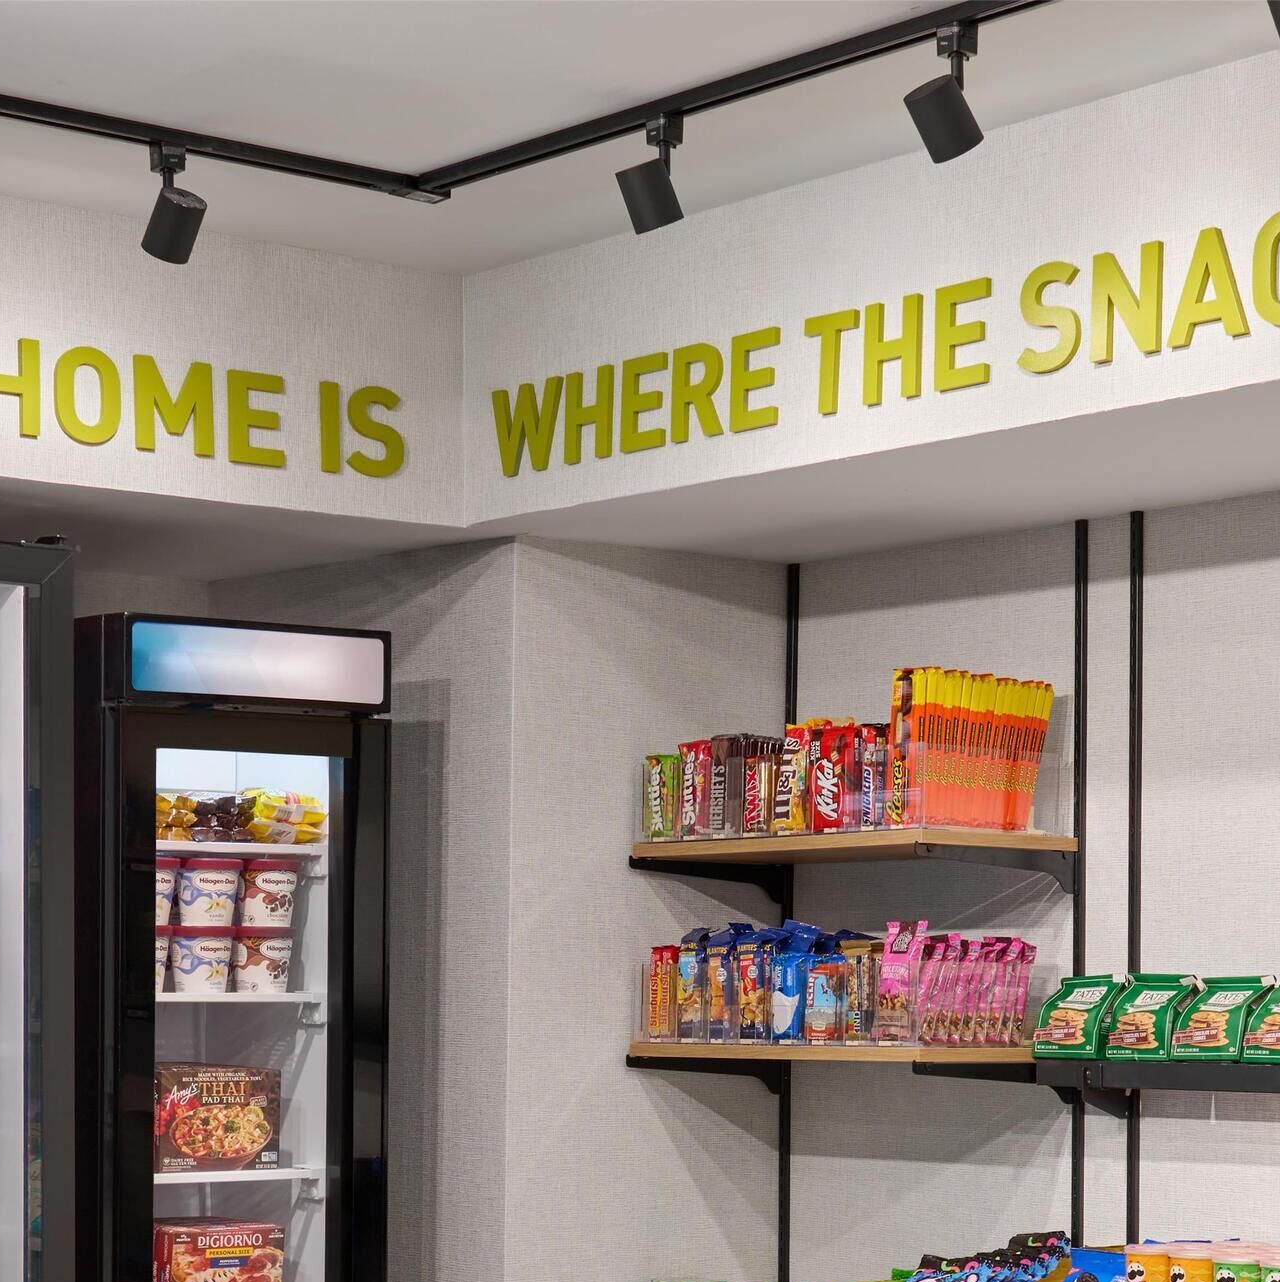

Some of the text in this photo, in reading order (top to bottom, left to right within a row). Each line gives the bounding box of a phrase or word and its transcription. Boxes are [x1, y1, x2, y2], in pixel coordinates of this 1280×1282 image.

[492, 327, 780, 477] WHERE
[805, 278, 992, 415] THE
[320, 381, 404, 477] IS
[682, 751, 696, 824] Skittles
[709, 765, 725, 831] HERSHEY'S
[744, 768, 762, 831] TWIX
[1073, 989, 1106, 1000] TATE'S
[165, 1083, 199, 1110] Amy's
[199, 1082, 246, 1095] THAI
